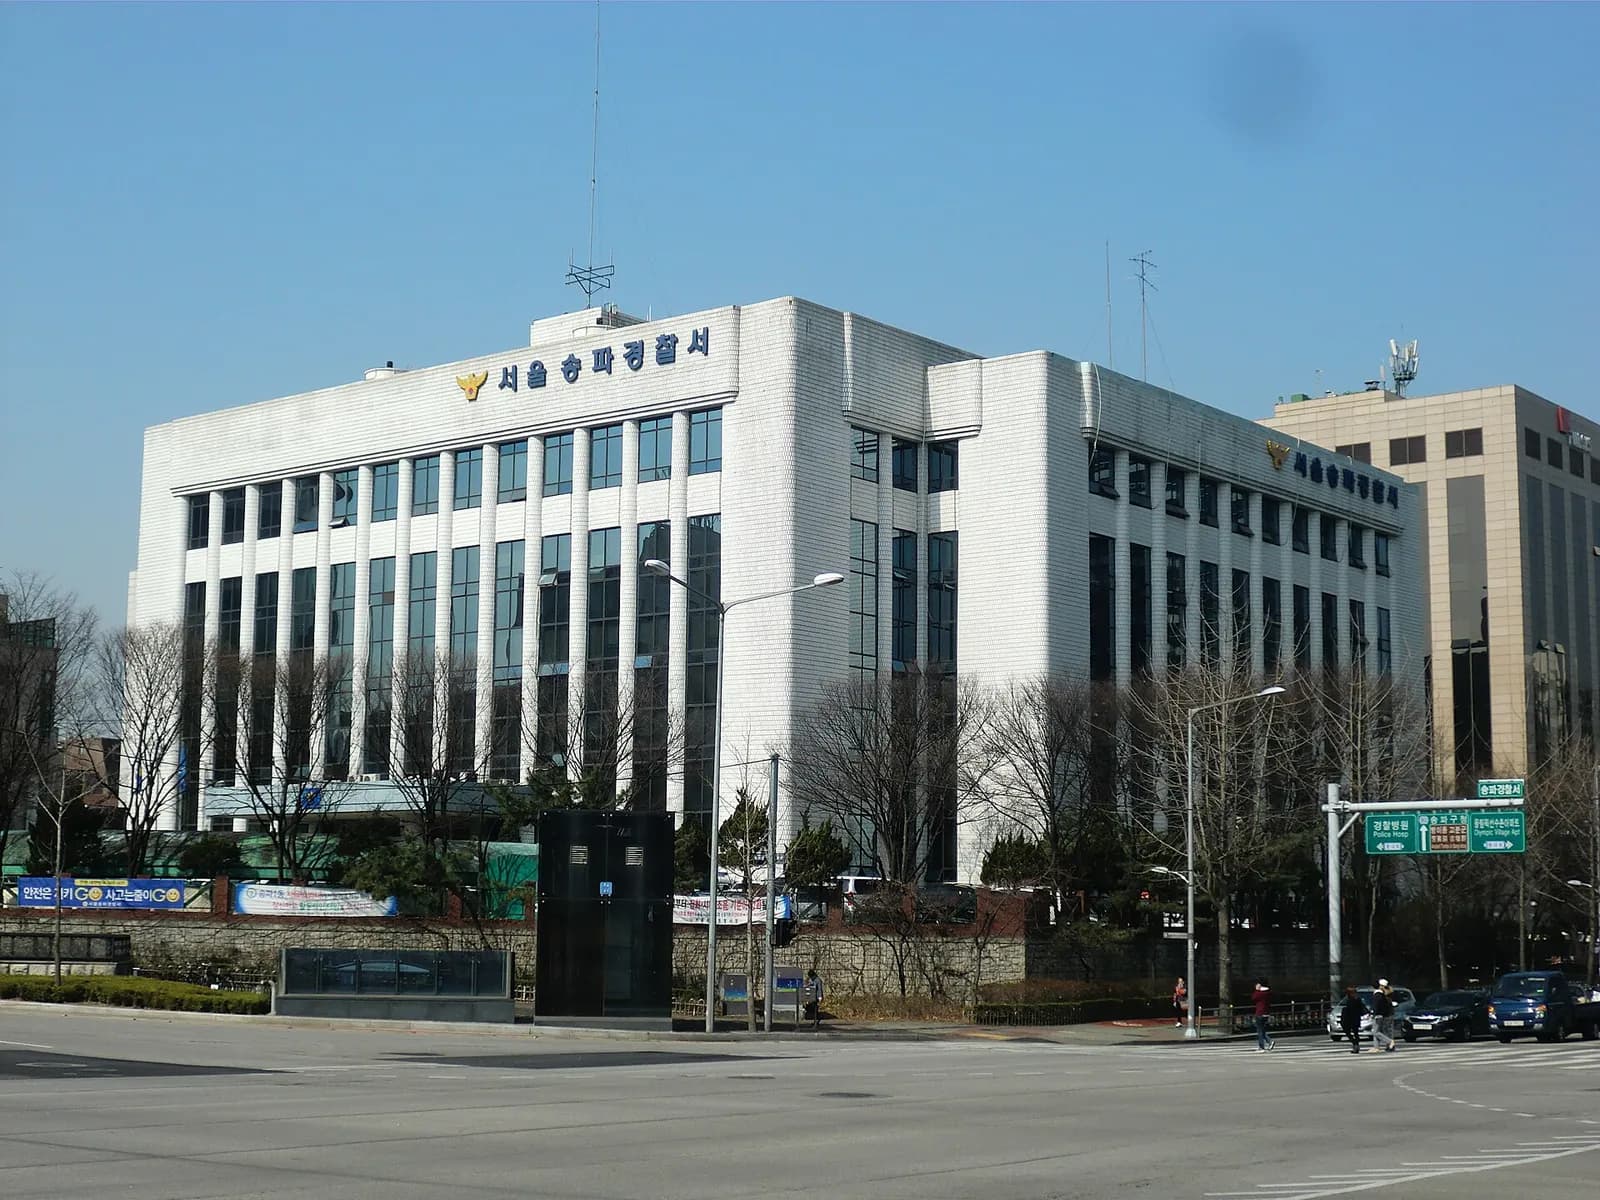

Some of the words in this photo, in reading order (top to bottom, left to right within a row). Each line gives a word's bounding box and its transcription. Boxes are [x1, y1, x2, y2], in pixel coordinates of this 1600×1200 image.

[498, 326, 710, 392] 서울송파경찰서
[1481, 783, 1521, 795] 송파경찰서
[1373, 820, 1409, 831] 경찰병원
[1430, 815, 1468, 825] 송파구청
[23, 887, 53, 900] 안전은
